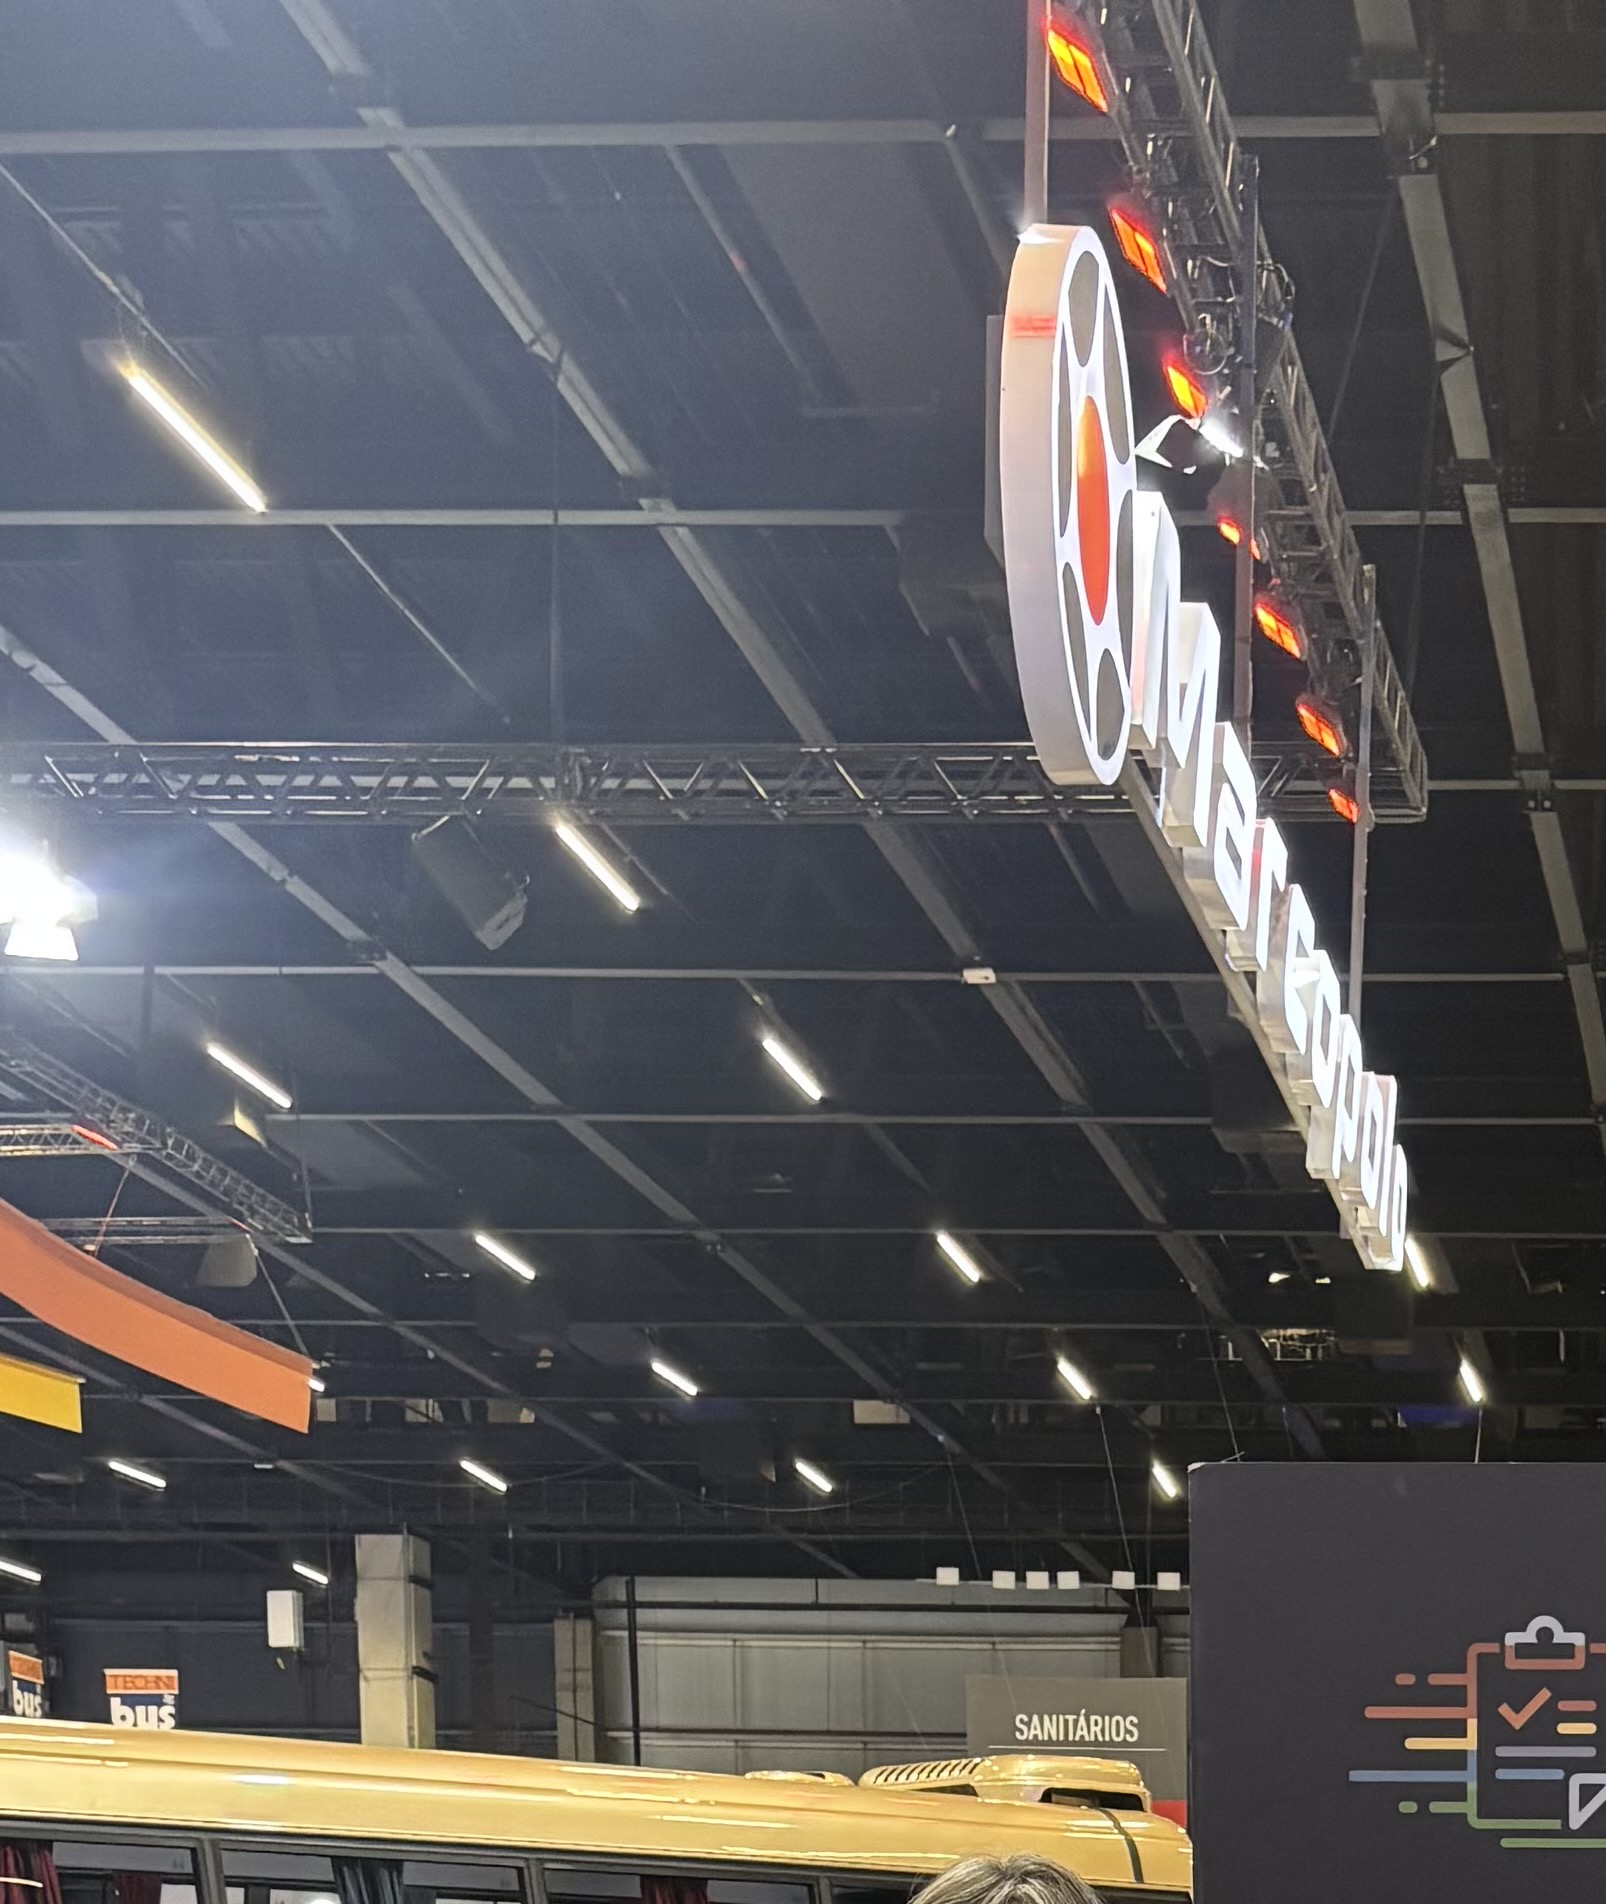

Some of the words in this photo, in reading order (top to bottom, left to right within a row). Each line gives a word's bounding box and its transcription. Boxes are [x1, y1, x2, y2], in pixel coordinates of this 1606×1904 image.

[1131, 490, 1407, 1270] Marcopolo
[12, 1679, 43, 1719] bus
[108, 1673, 177, 1691] TECHNI
[110, 1696, 176, 1730] bus
[1014, 1708, 1139, 1743] SANITÁRIOS
